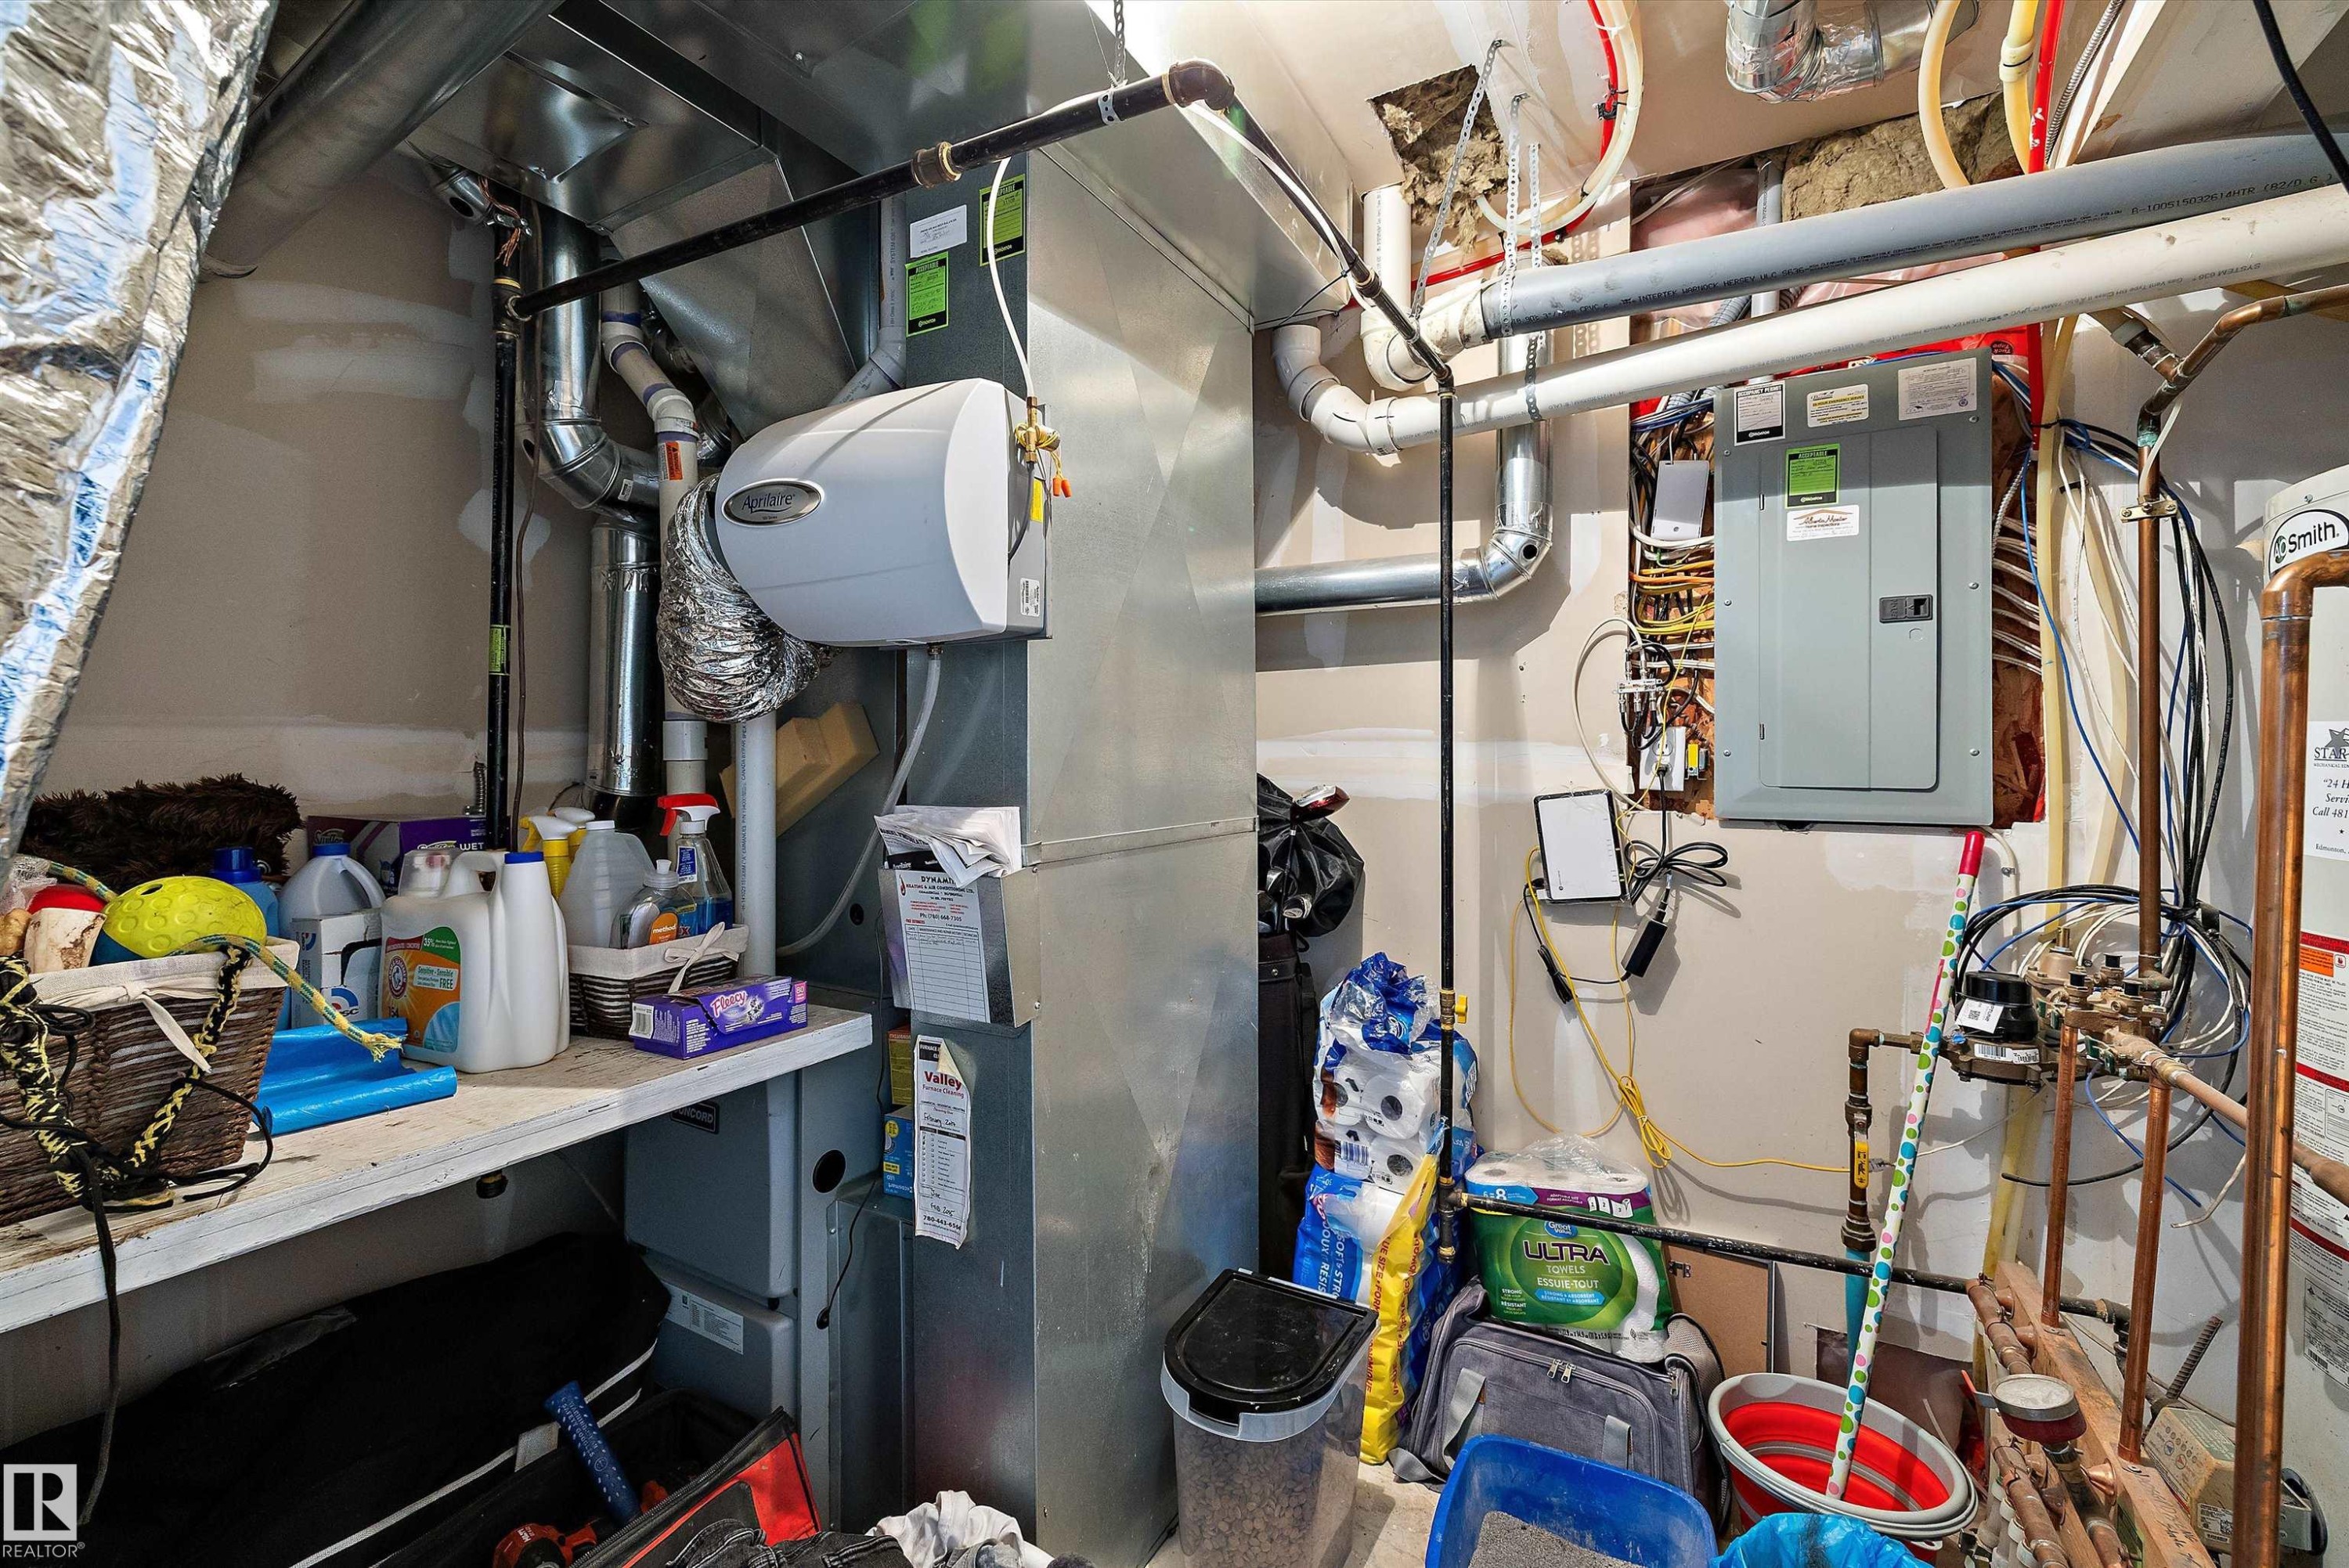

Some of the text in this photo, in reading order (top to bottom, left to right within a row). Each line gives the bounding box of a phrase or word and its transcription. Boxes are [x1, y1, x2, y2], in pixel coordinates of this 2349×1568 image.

[1723, 276, 1755, 287] HERSEY
[742, 492, 793, 514] Aprilaire
[2288, 521, 2336, 553] Smith
[2312, 806, 2330, 817] Call
[460, 842, 484, 851] WET
[652, 925, 677, 934] method
[439, 978, 453, 989] FREE
[711, 991, 748, 1017] Fleecy
[919, 1044, 937, 1052] FURNACE
[924, 1070, 962, 1091] Valley
[922, 1083, 965, 1099] Furnace Cleaning
[673, 1106, 714, 1124] ONCORD
[1548, 1220, 1571, 1231] Great
[1553, 1227, 1572, 1236] Value
[1523, 1239, 1611, 1266] ULTRA
[1546, 1265, 1586, 1274] TOWELS
[1537, 1277, 1600, 1289] ESSUIE-TOUT
